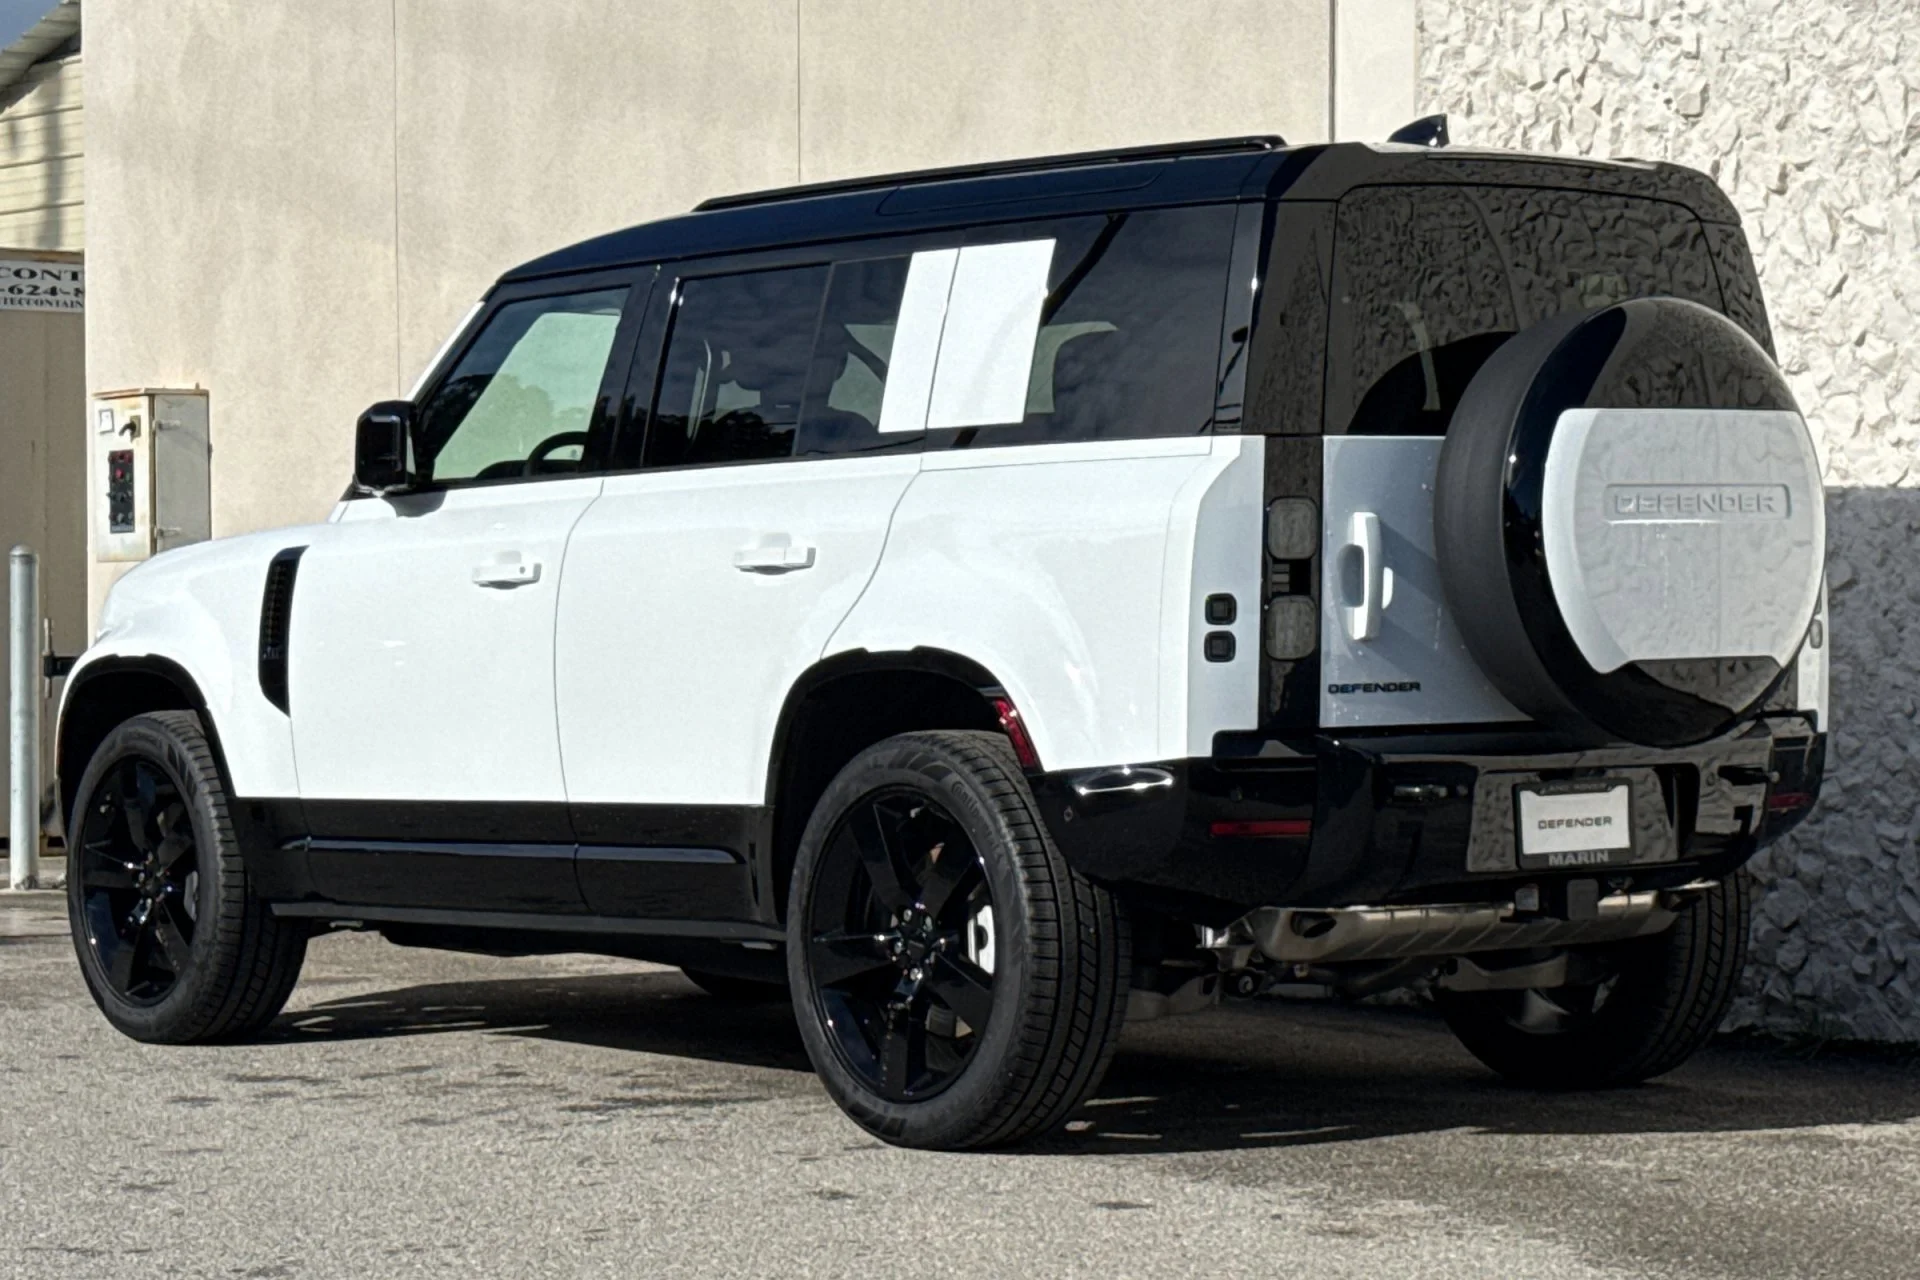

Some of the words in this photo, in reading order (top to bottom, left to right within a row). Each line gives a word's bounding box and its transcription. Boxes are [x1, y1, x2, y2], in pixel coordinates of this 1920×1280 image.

[1615, 493, 1777, 515] DEFENDER
[1328, 682, 1421, 694] DEFENDER
[1537, 816, 1612, 830] DEFENDER
[1548, 850, 1609, 866] MARIN
